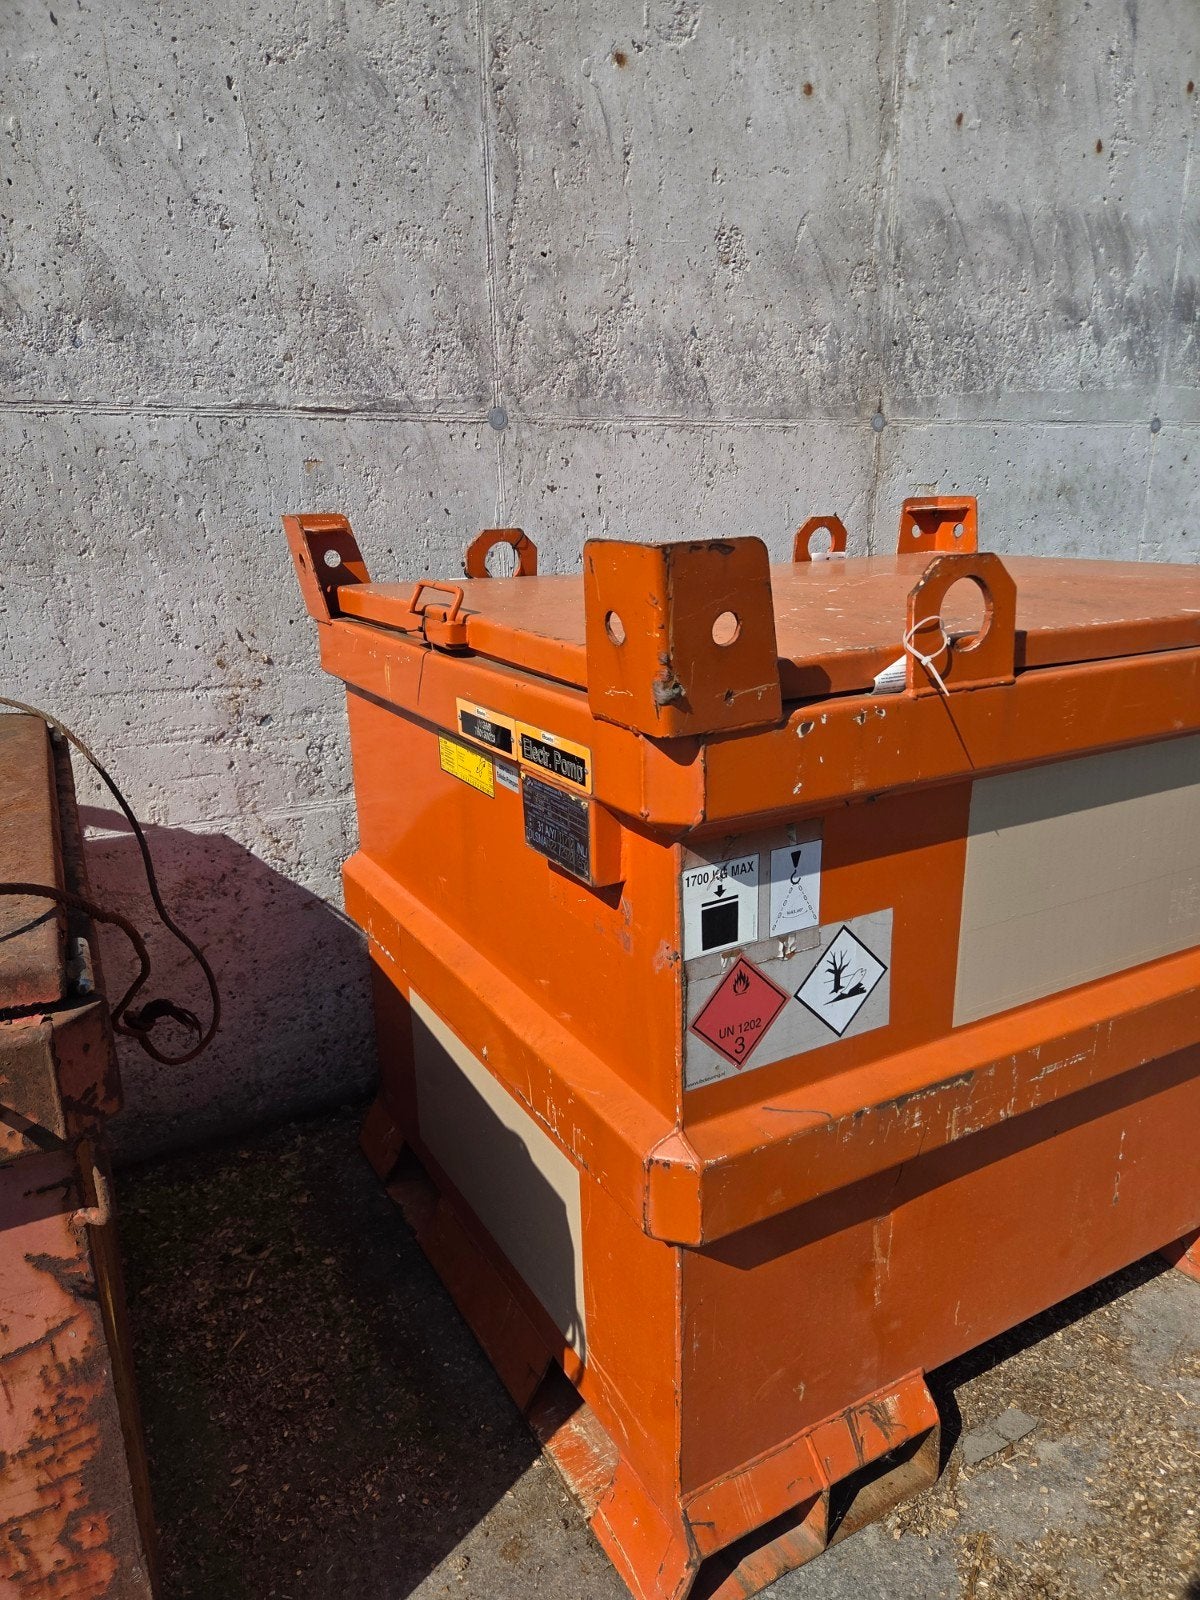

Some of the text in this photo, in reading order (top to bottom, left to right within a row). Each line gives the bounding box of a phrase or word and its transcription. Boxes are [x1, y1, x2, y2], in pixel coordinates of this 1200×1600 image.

[522, 737, 552, 768] Electr.
[553, 750, 584, 783] Pomp
[685, 861, 754, 888] 1700 KG MAX
[719, 1018, 762, 1039] UN 1202
[734, 1036, 746, 1054] 3
